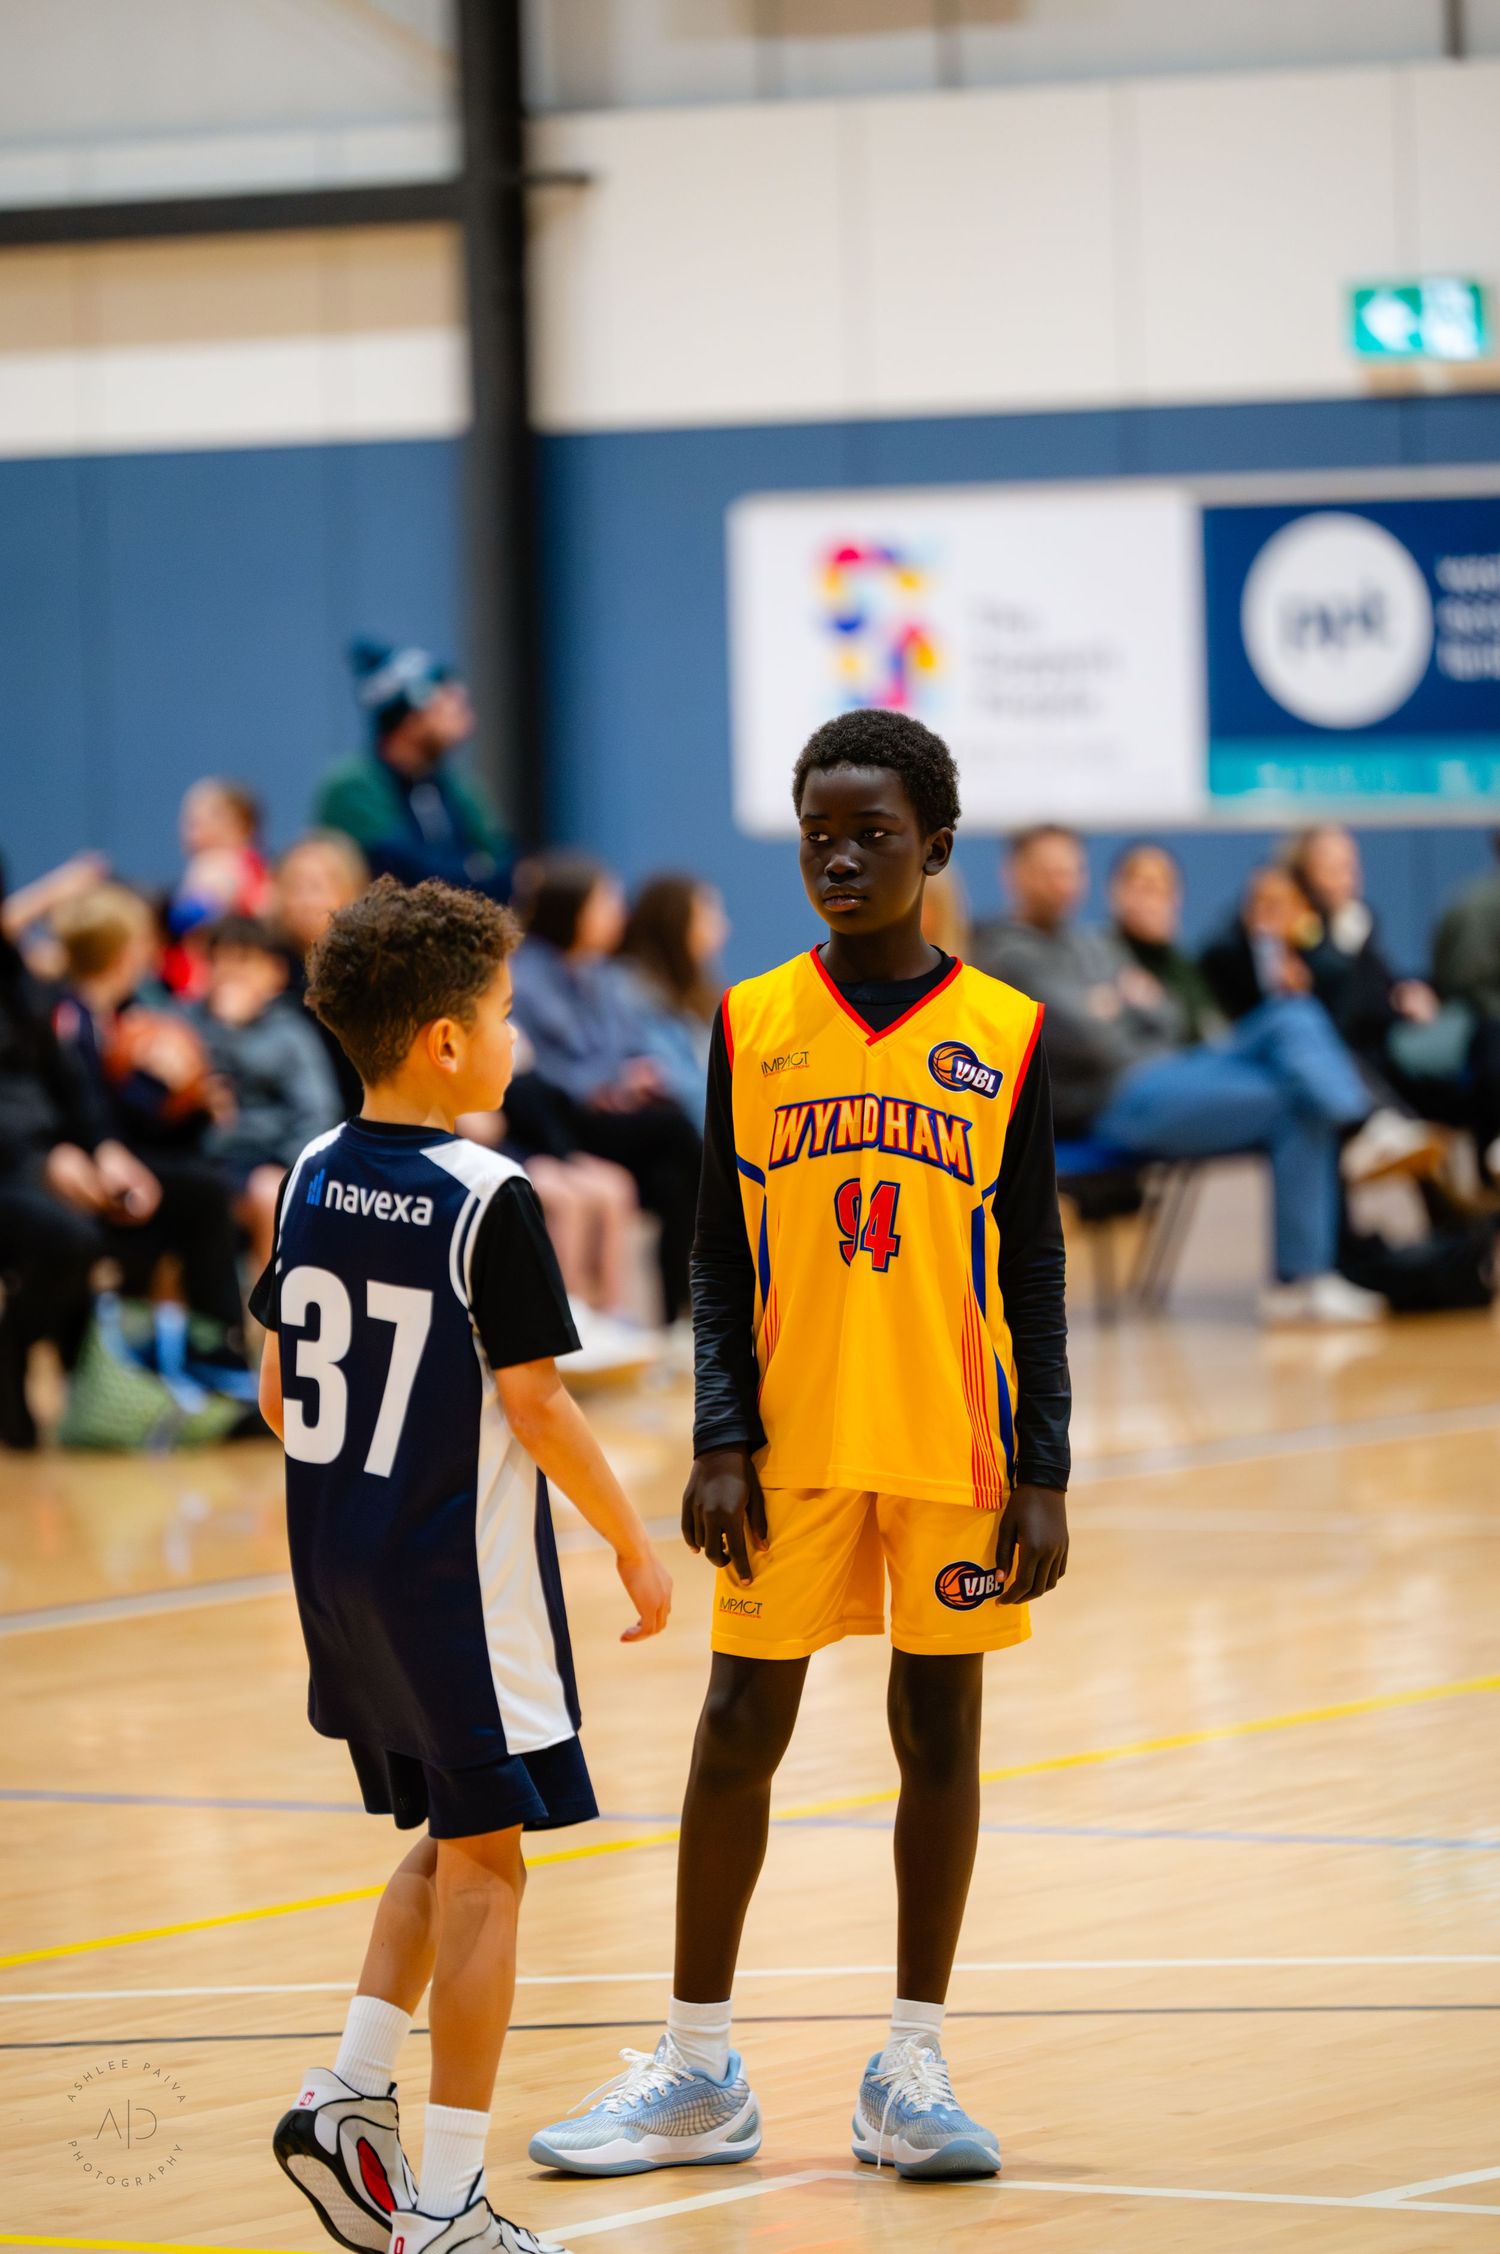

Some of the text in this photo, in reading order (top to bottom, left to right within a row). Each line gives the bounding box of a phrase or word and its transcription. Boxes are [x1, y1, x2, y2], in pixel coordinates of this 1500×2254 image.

[761, 1051, 809, 1075] IMPACT
[955, 1060, 996, 1093] VJBL
[768, 1093, 974, 1185] WYNDHAM
[325, 1180, 434, 1226] navexa
[834, 1178, 901, 1273] 94
[281, 1265, 434, 1478] 37
